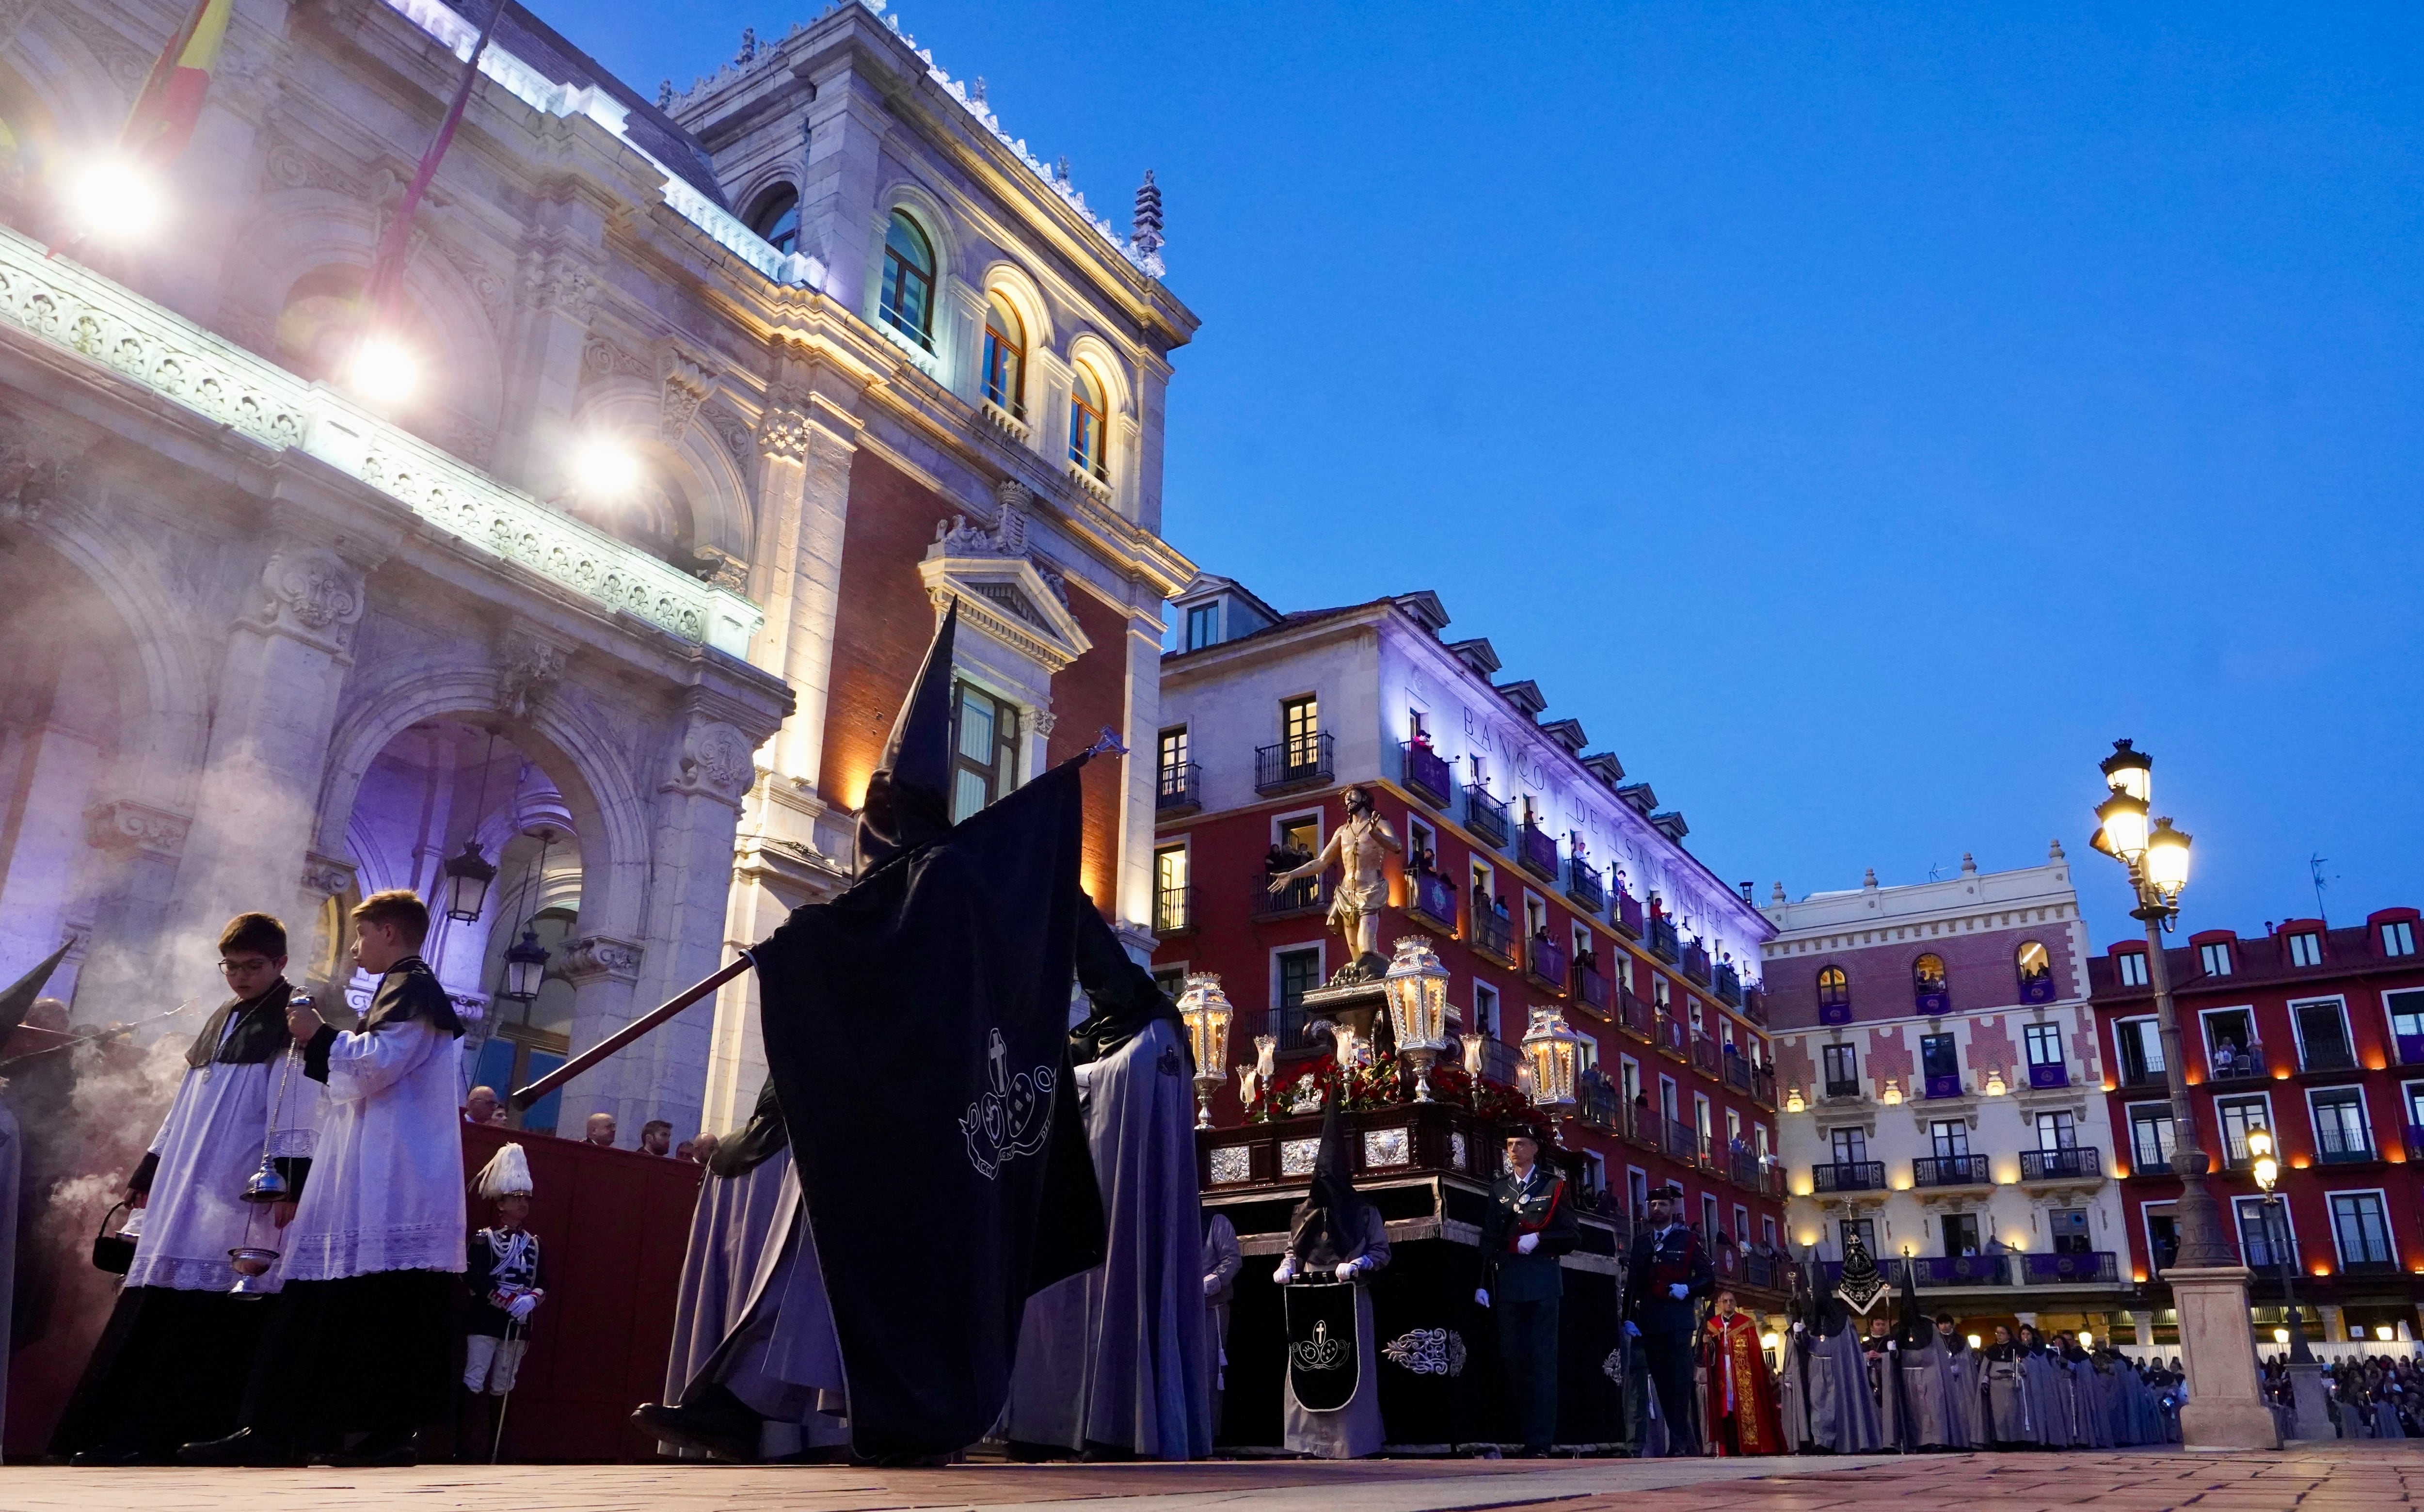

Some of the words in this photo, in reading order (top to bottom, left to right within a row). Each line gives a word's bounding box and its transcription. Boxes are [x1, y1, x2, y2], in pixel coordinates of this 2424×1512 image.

[1464, 706, 1544, 790] BANCO
[1576, 797, 1598, 835] DE
[1626, 838, 1723, 933] SANTANDER
